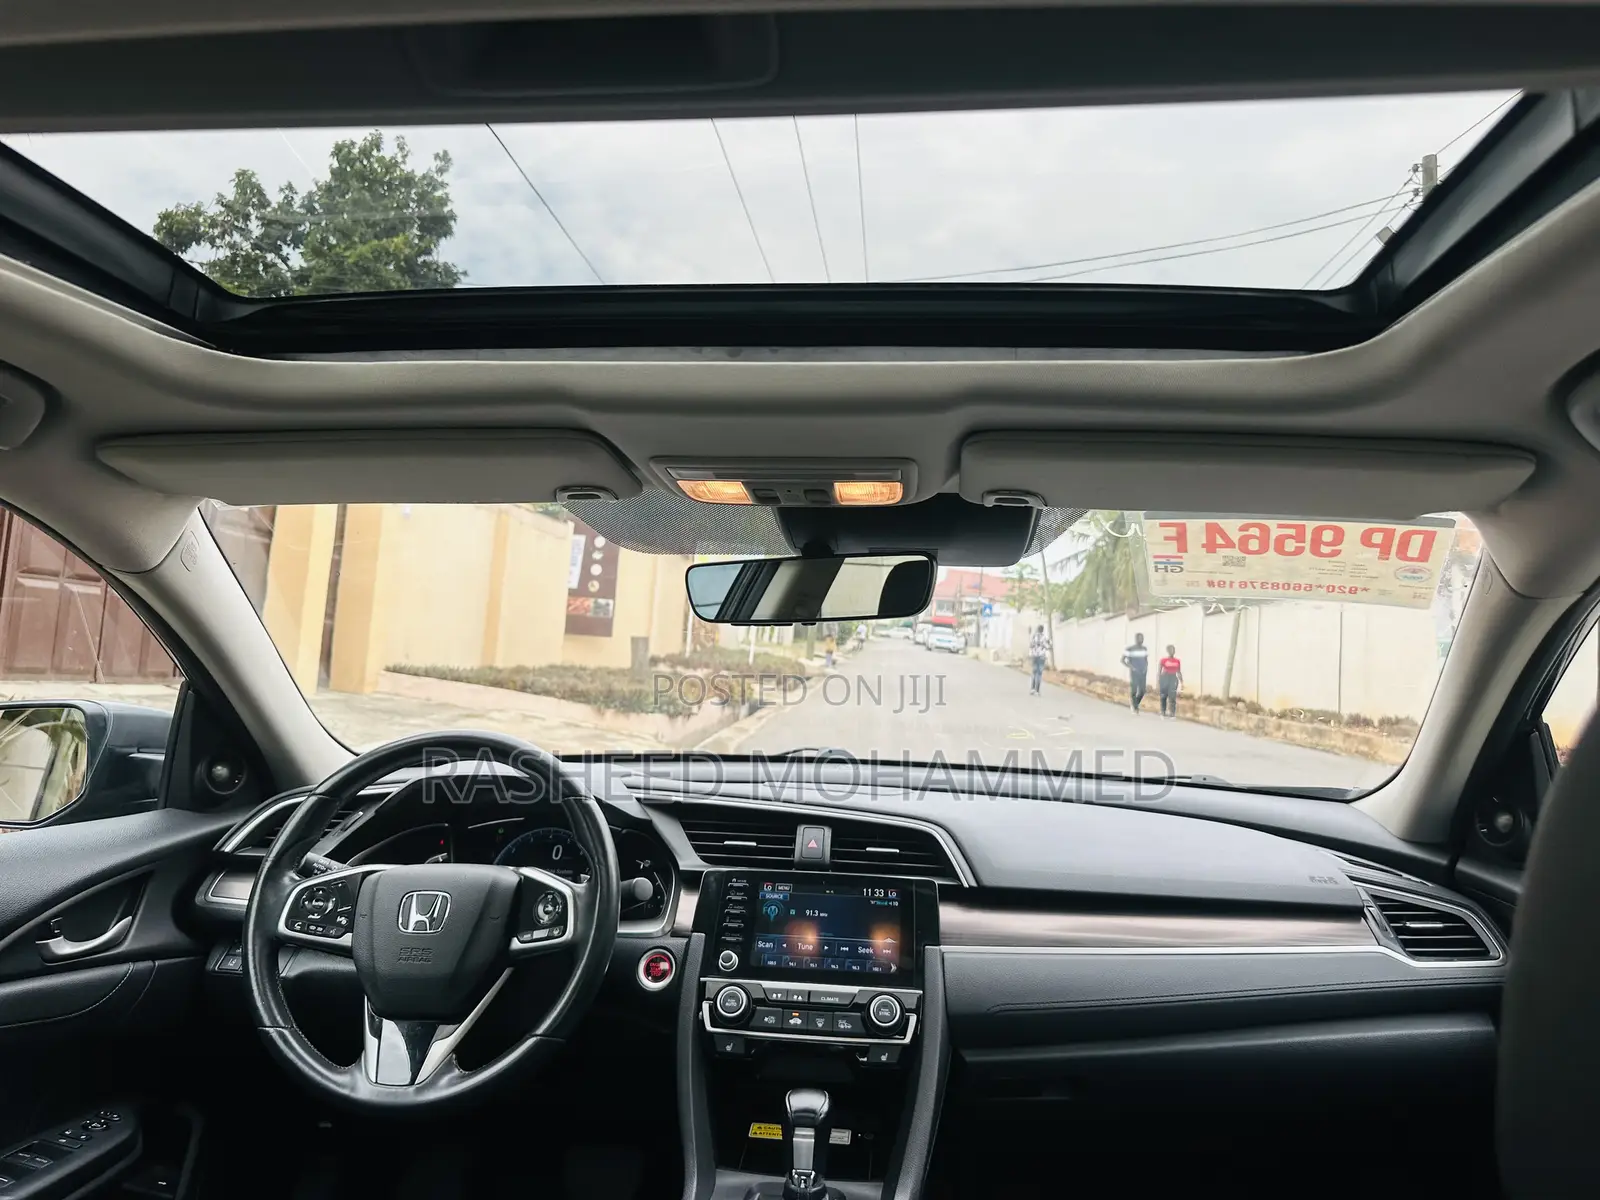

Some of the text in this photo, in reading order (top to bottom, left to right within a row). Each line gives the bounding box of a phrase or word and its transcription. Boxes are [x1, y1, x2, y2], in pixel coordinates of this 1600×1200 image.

[552, 844, 563, 860] 0
[805, 909, 819, 917] 91.3
[757, 940, 773, 949] Scan
[798, 942, 814, 951] Tune
[857, 946, 874, 955] Seek
